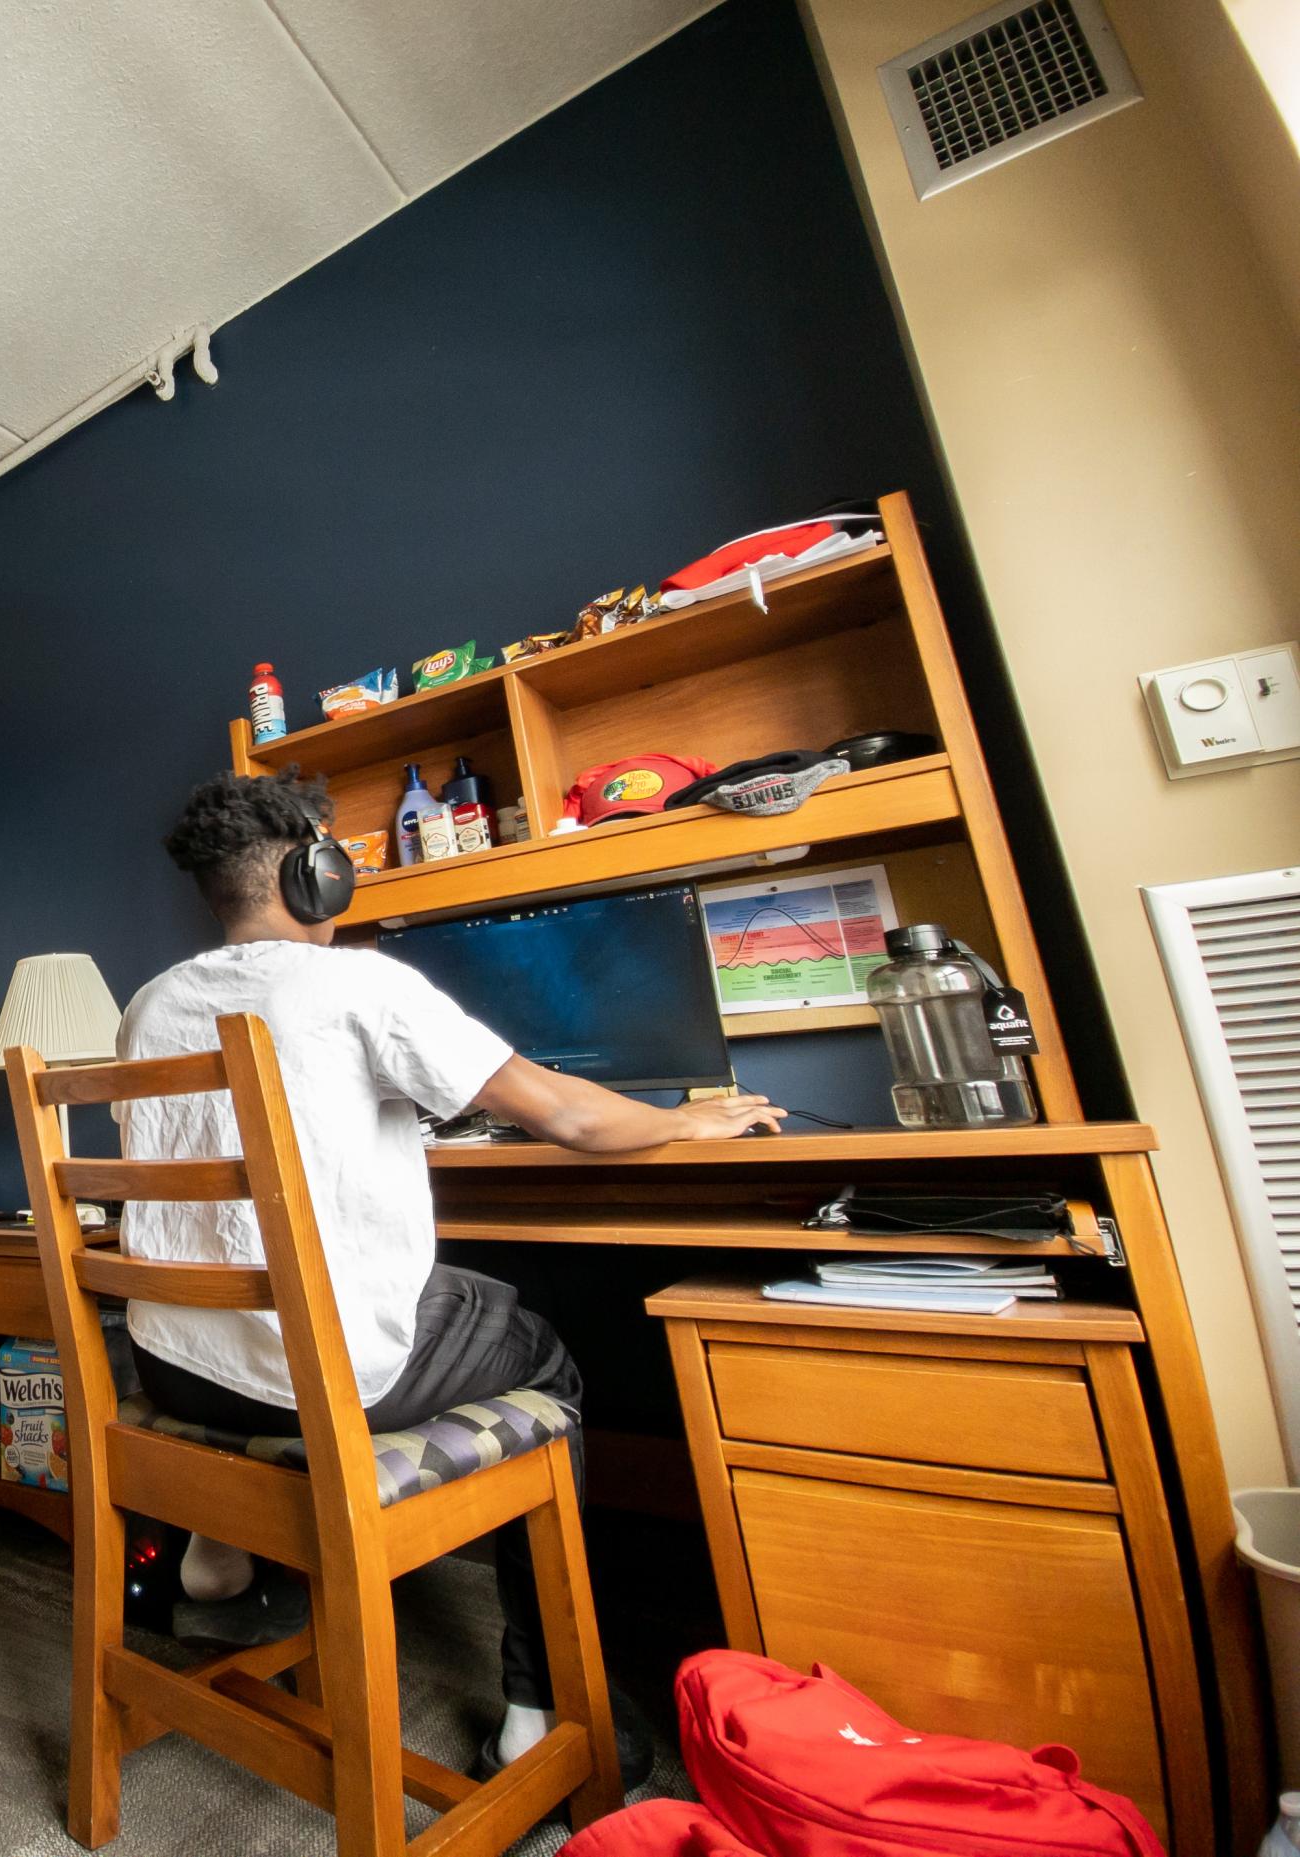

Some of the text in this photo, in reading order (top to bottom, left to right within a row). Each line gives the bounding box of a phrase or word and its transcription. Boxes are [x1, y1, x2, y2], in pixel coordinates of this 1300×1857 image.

[249, 682, 273, 737] PRIME
[989, 1019, 1029, 1031] aquafit
[3, 1378, 63, 1401] Welch's
[21, 1420, 44, 1433] Fruit
[14, 1429, 49, 1444] Snacks
